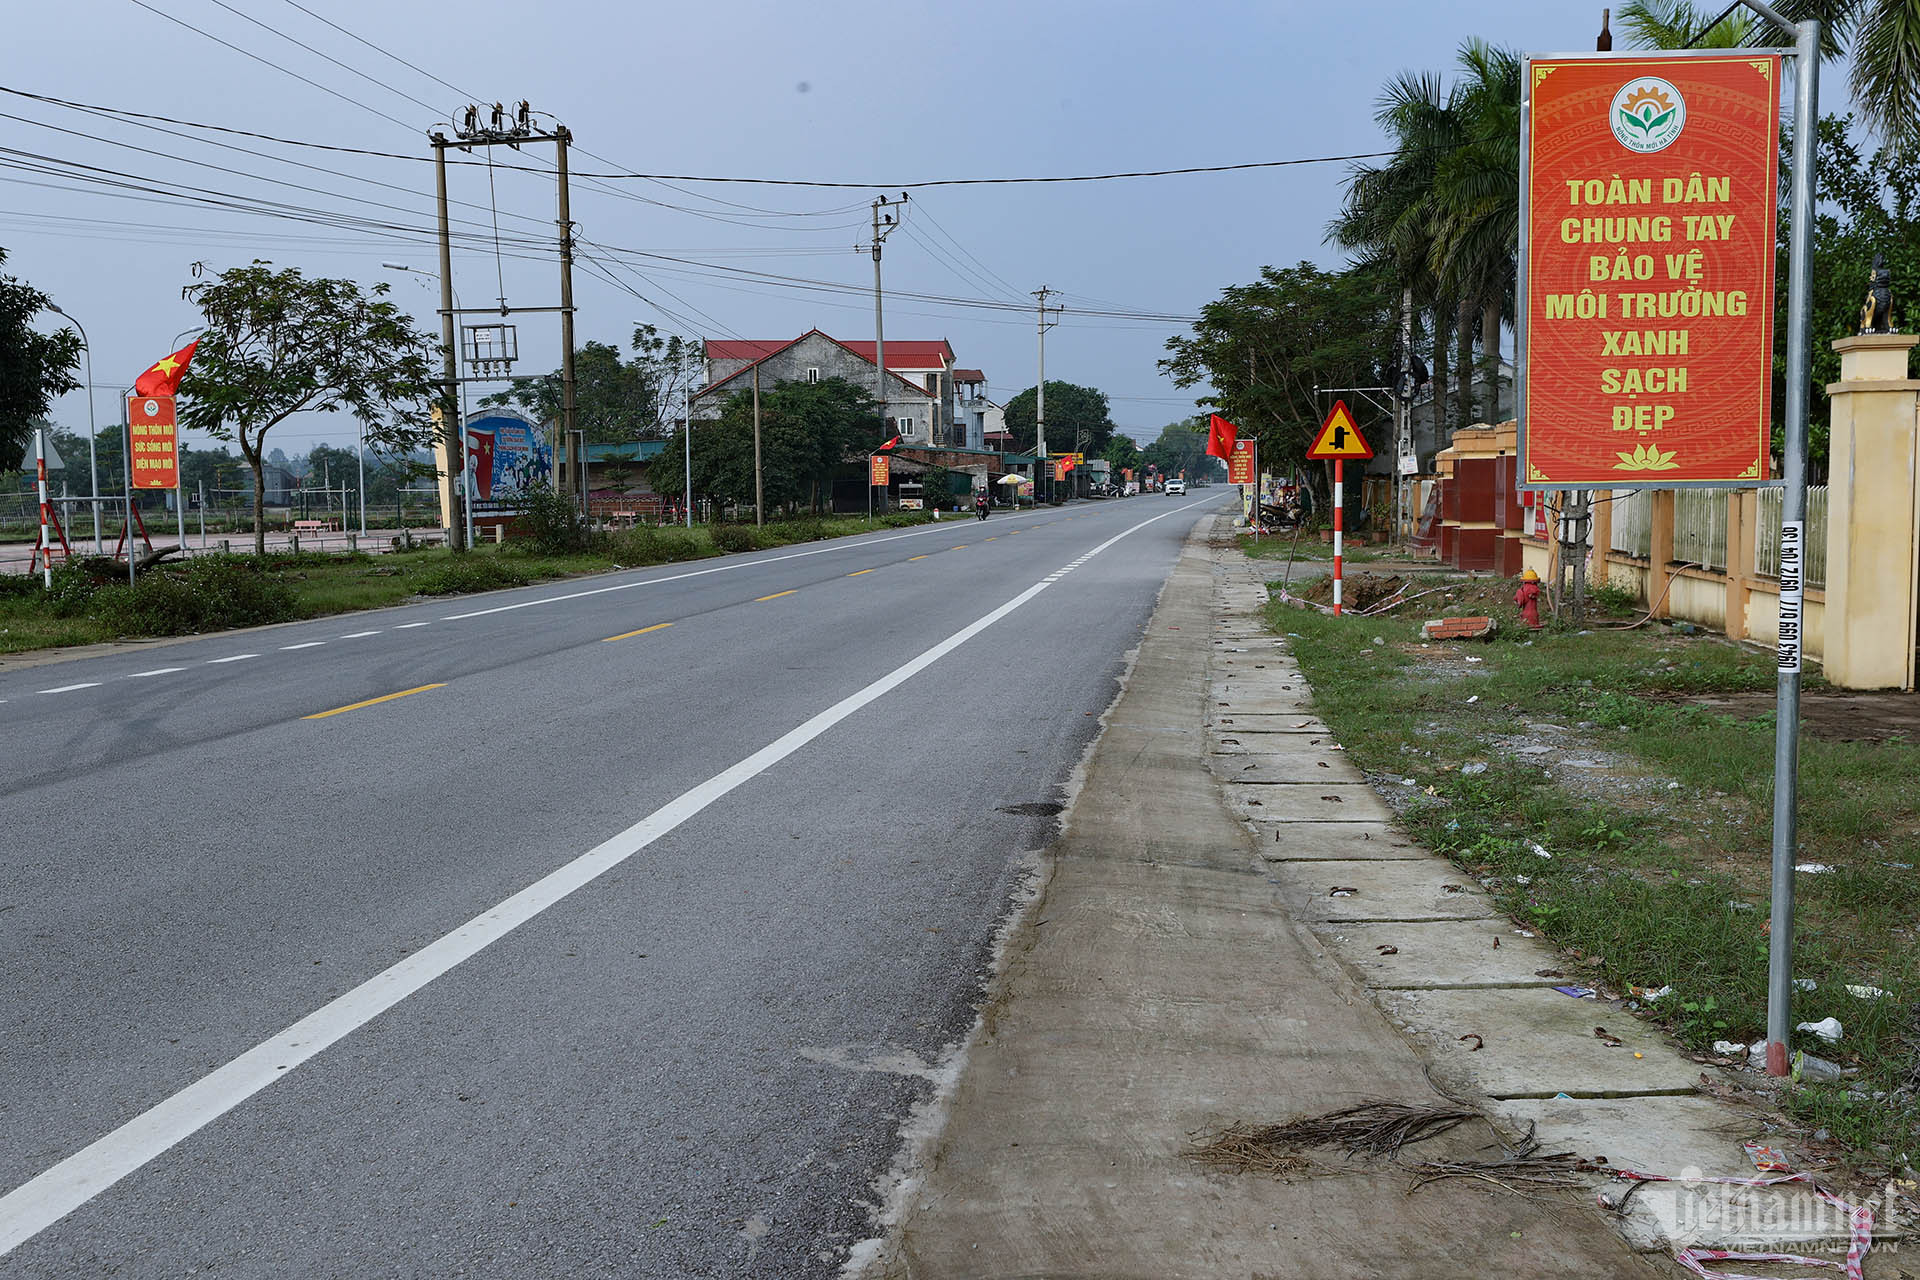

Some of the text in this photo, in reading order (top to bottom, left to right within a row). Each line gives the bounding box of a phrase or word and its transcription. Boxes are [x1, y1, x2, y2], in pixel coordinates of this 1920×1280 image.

[1566, 171, 1730, 206] TOÀN DÂN
[1560, 214, 1736, 244] CHUNG TAY
[1590, 246, 1704, 285] BẢO VỆ
[1545, 285, 1747, 319] MÔI TRƯỜNG
[1601, 329, 1689, 357] XANH
[1601, 367, 1688, 399] SẠCH
[1611, 405, 1675, 436] ĐẸP
[1780, 526, 1799, 592] 0972 704 136
[1778, 600, 1798, 669] 0943 099 677
